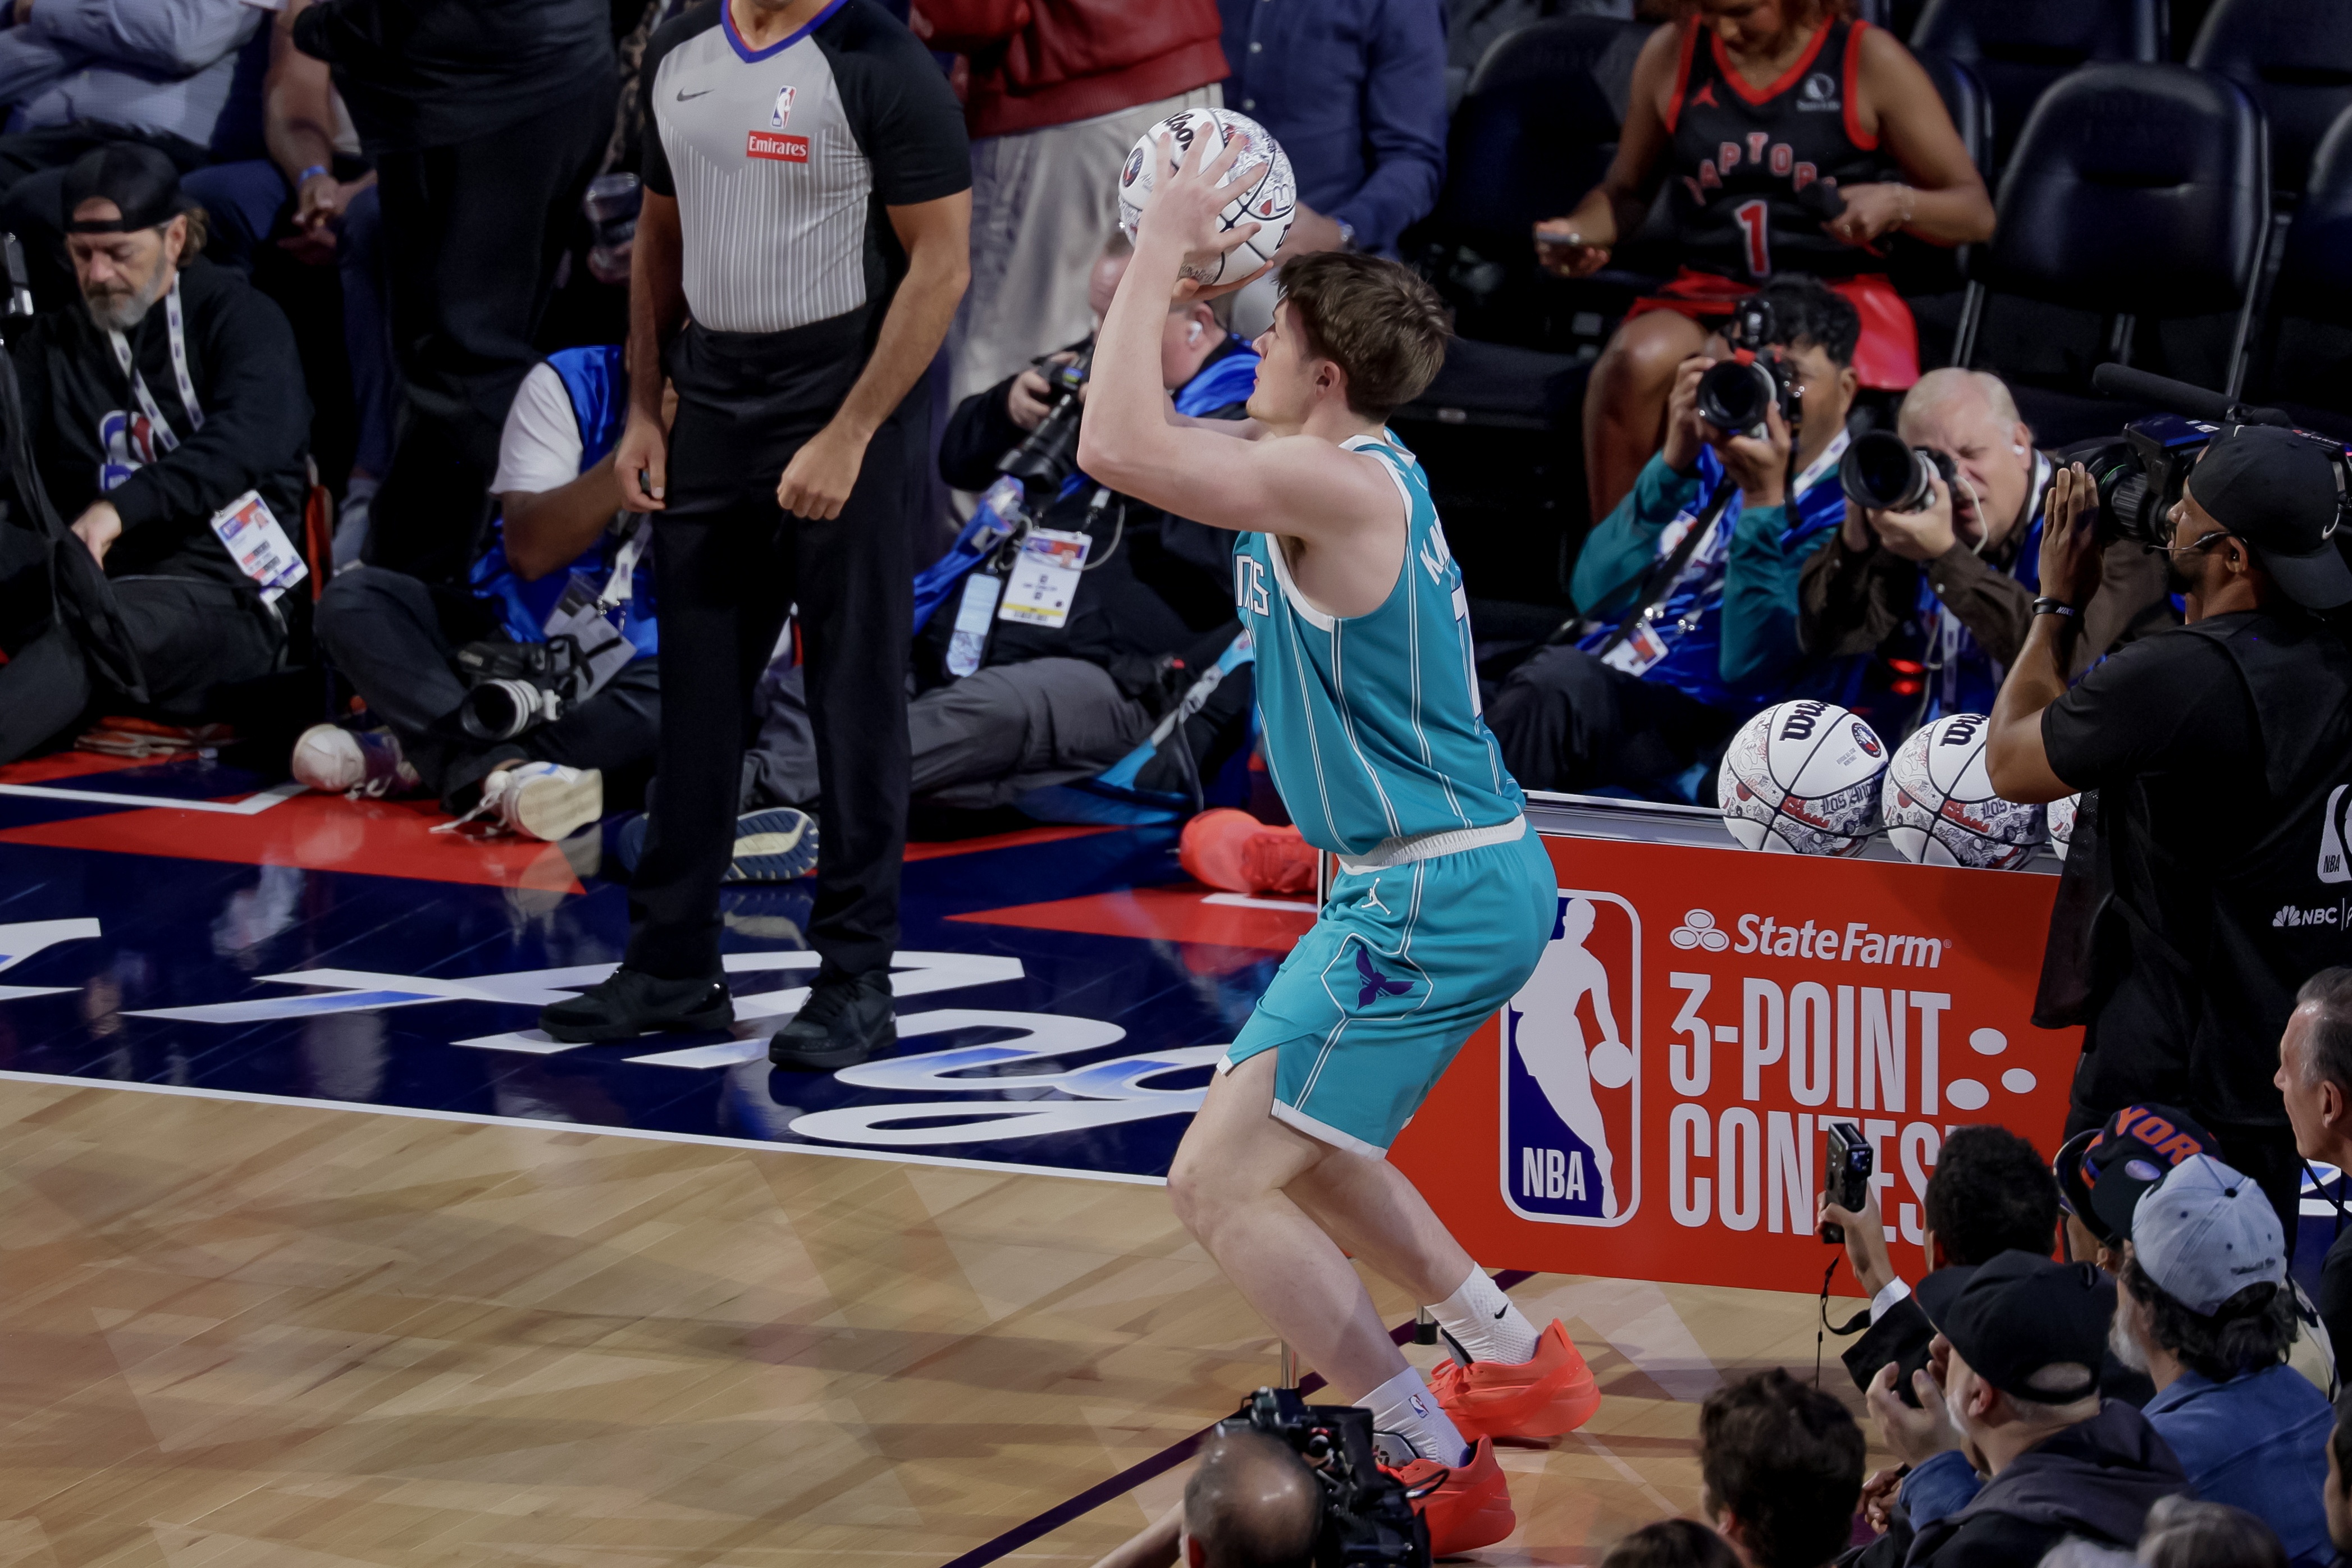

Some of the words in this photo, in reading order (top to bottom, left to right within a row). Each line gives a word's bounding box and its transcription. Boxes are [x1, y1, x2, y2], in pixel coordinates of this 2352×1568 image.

[748, 136, 807, 157] Emirates
[1683, 132, 1837, 206] APTOR
[1734, 199, 1771, 277] 1
[2323, 854, 2341, 874] NBA
[2301, 907, 2337, 925] NBC
[1669, 971, 1952, 1116] 3-POINT
[2115, 1105, 2217, 1166] YOR
[1523, 1146, 1587, 1202] NBA
[1669, 1102, 1956, 1246] CONES
